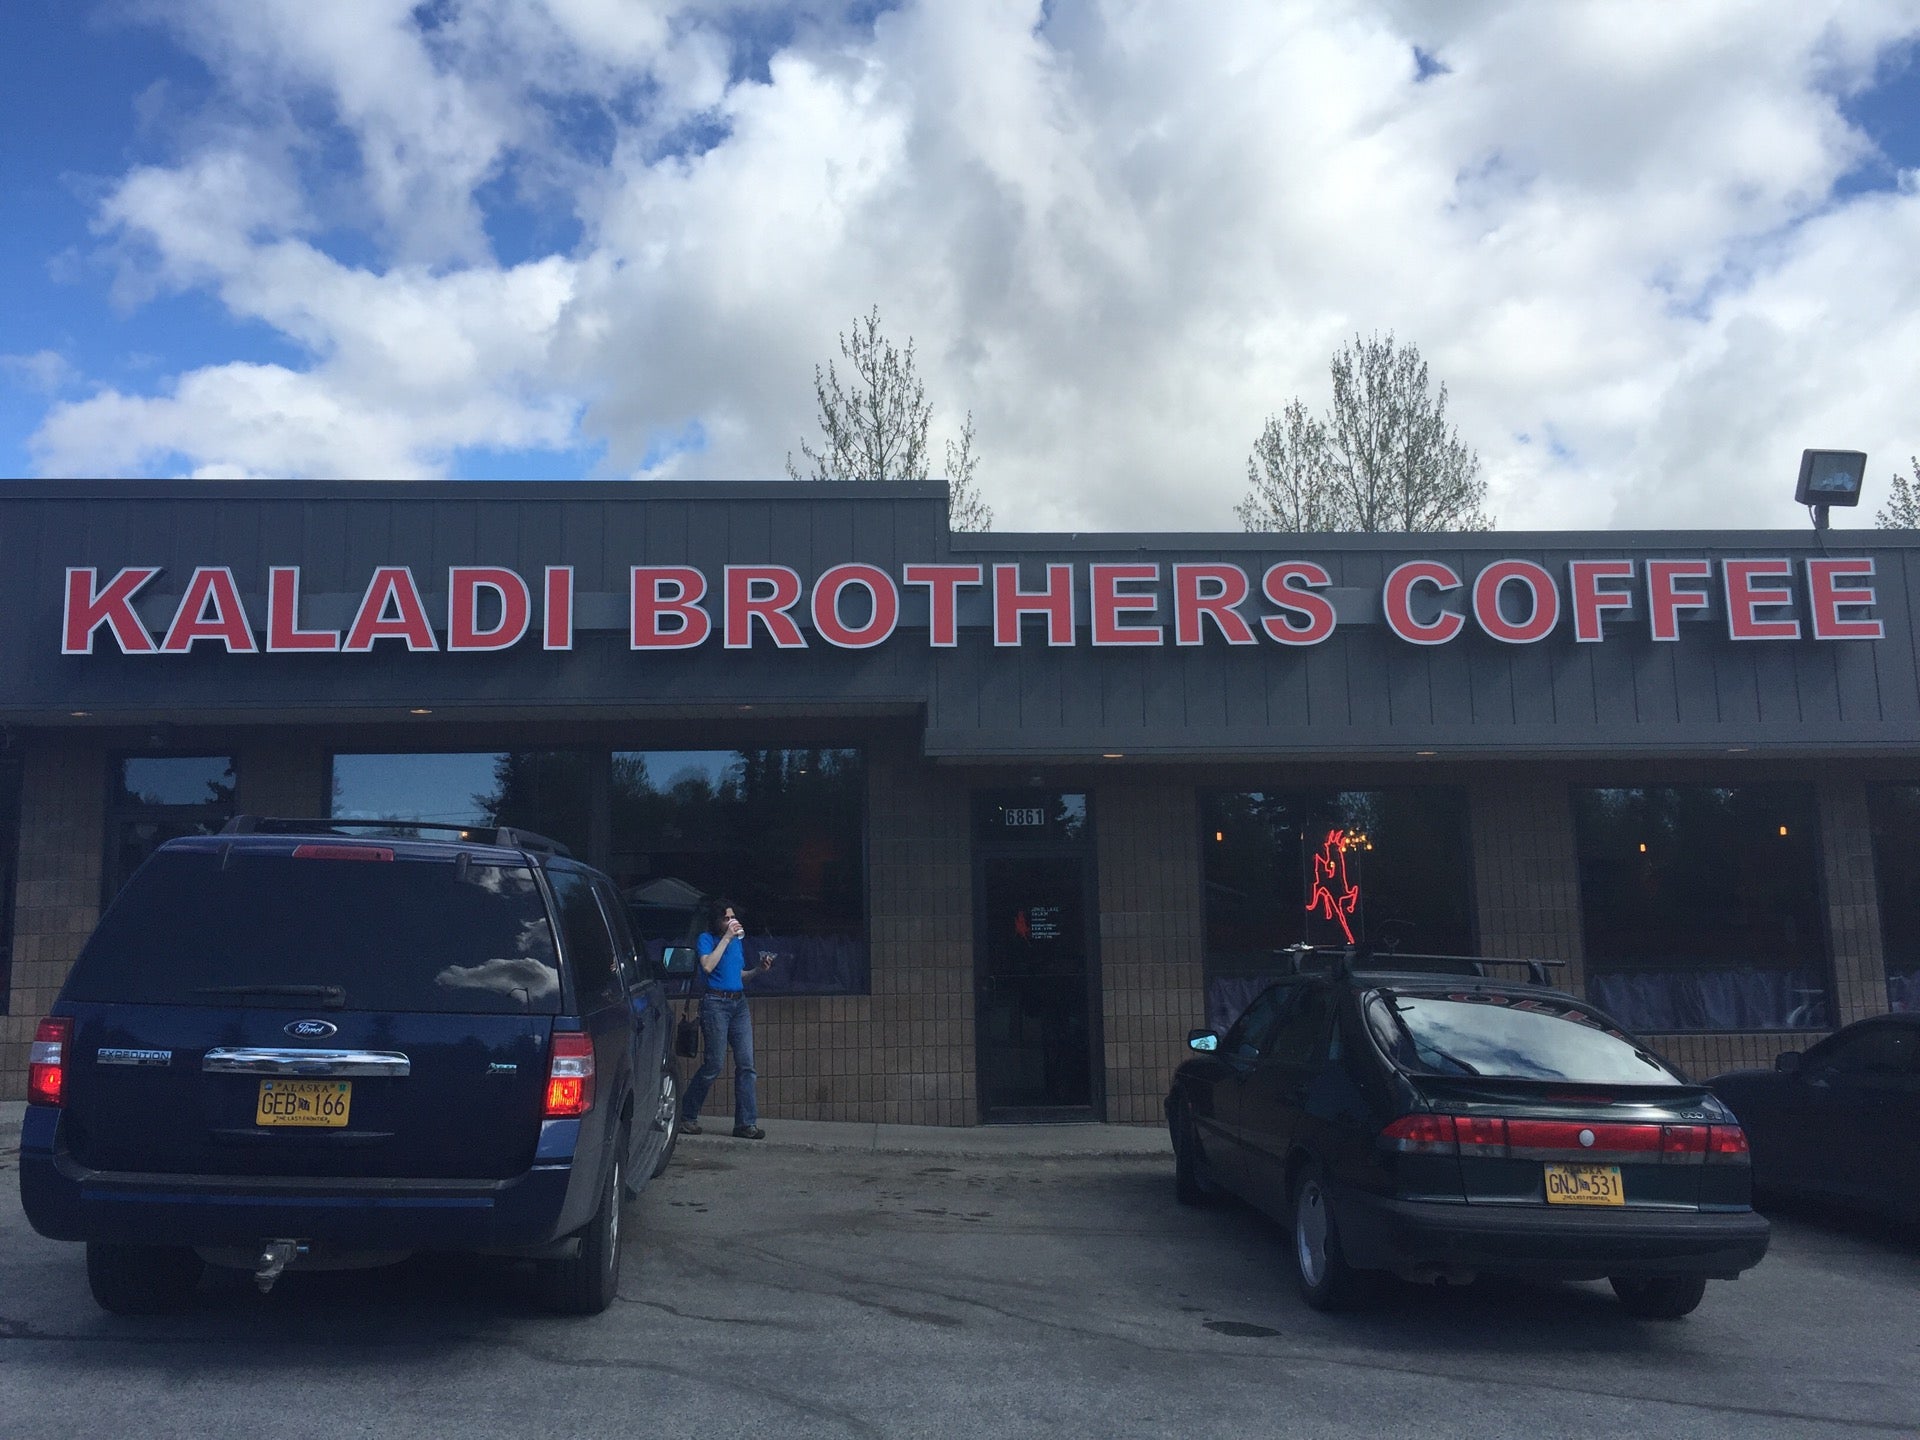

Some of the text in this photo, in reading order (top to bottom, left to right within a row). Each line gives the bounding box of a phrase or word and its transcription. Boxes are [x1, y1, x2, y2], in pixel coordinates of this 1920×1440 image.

[61, 557, 1885, 656] KALADI BROTHERS COFFEE
[1007, 810, 1042, 825] 6861
[295, 1022, 325, 1034] Ford
[99, 1050, 170, 1060] EXPEDITION
[282, 1083, 330, 1093] ALASKA
[261, 1092, 345, 1116] GEB 166
[1549, 1174, 1618, 1196] GNJ 531
